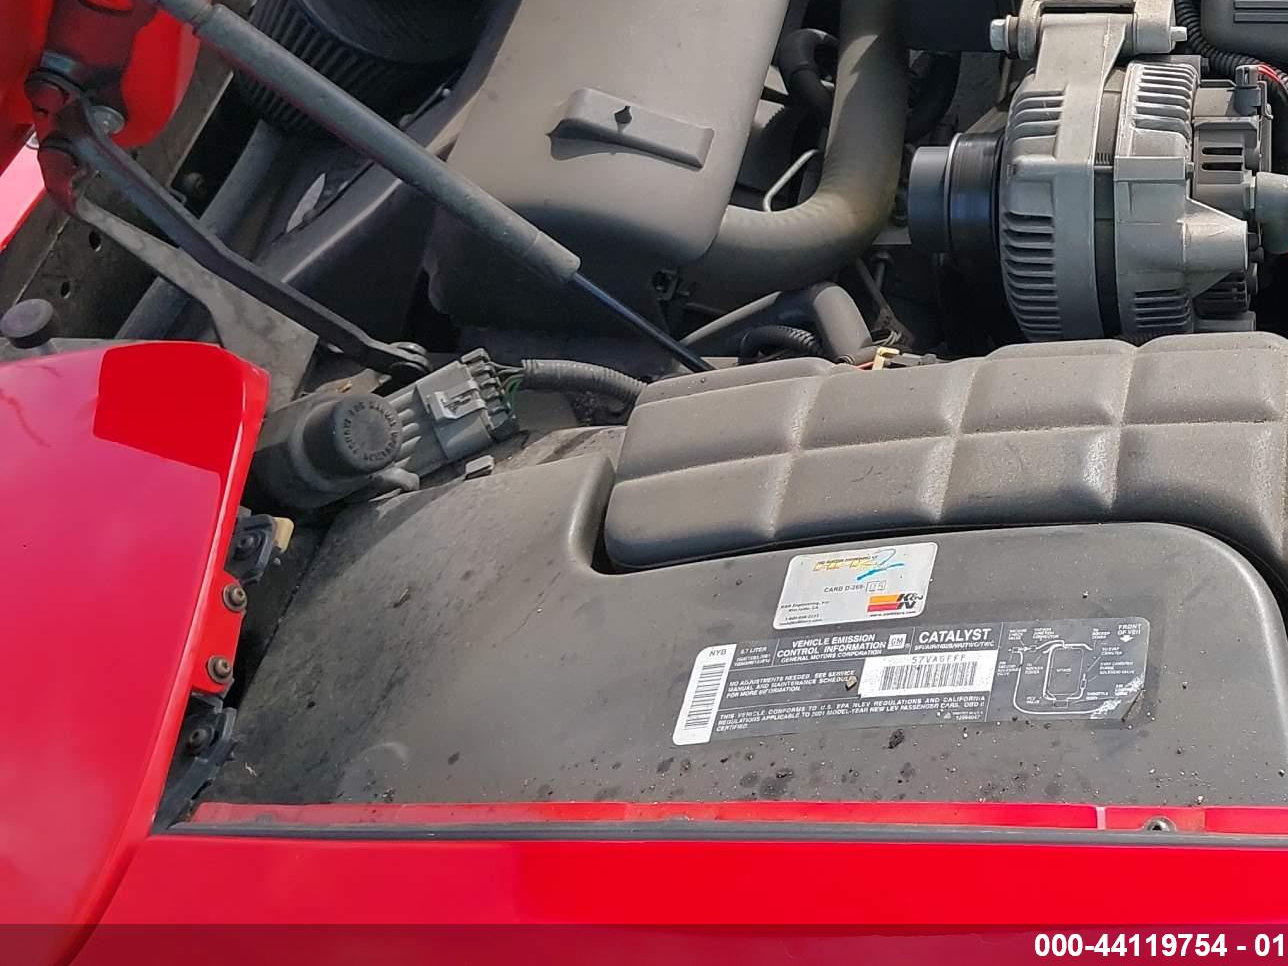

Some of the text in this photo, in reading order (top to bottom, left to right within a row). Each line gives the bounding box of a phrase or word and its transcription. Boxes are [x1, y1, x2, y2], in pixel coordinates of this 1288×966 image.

[792, 634, 876, 648] VEHICLE EMISSION
[918, 628, 992, 644] CATALYST
[709, 648, 727, 657] NYB
[777, 641, 887, 658] CONTROL INFORMATION
[781, 655, 811, 663] GENERAL
[812, 653, 836, 661] MOTORS
[837, 649, 883, 659] CORPORATION
[873, 697, 922, 706] REGULATIONS
[942, 694, 986, 703] CALIFORNIA
[900, 702, 940, 711] PASSENGER
